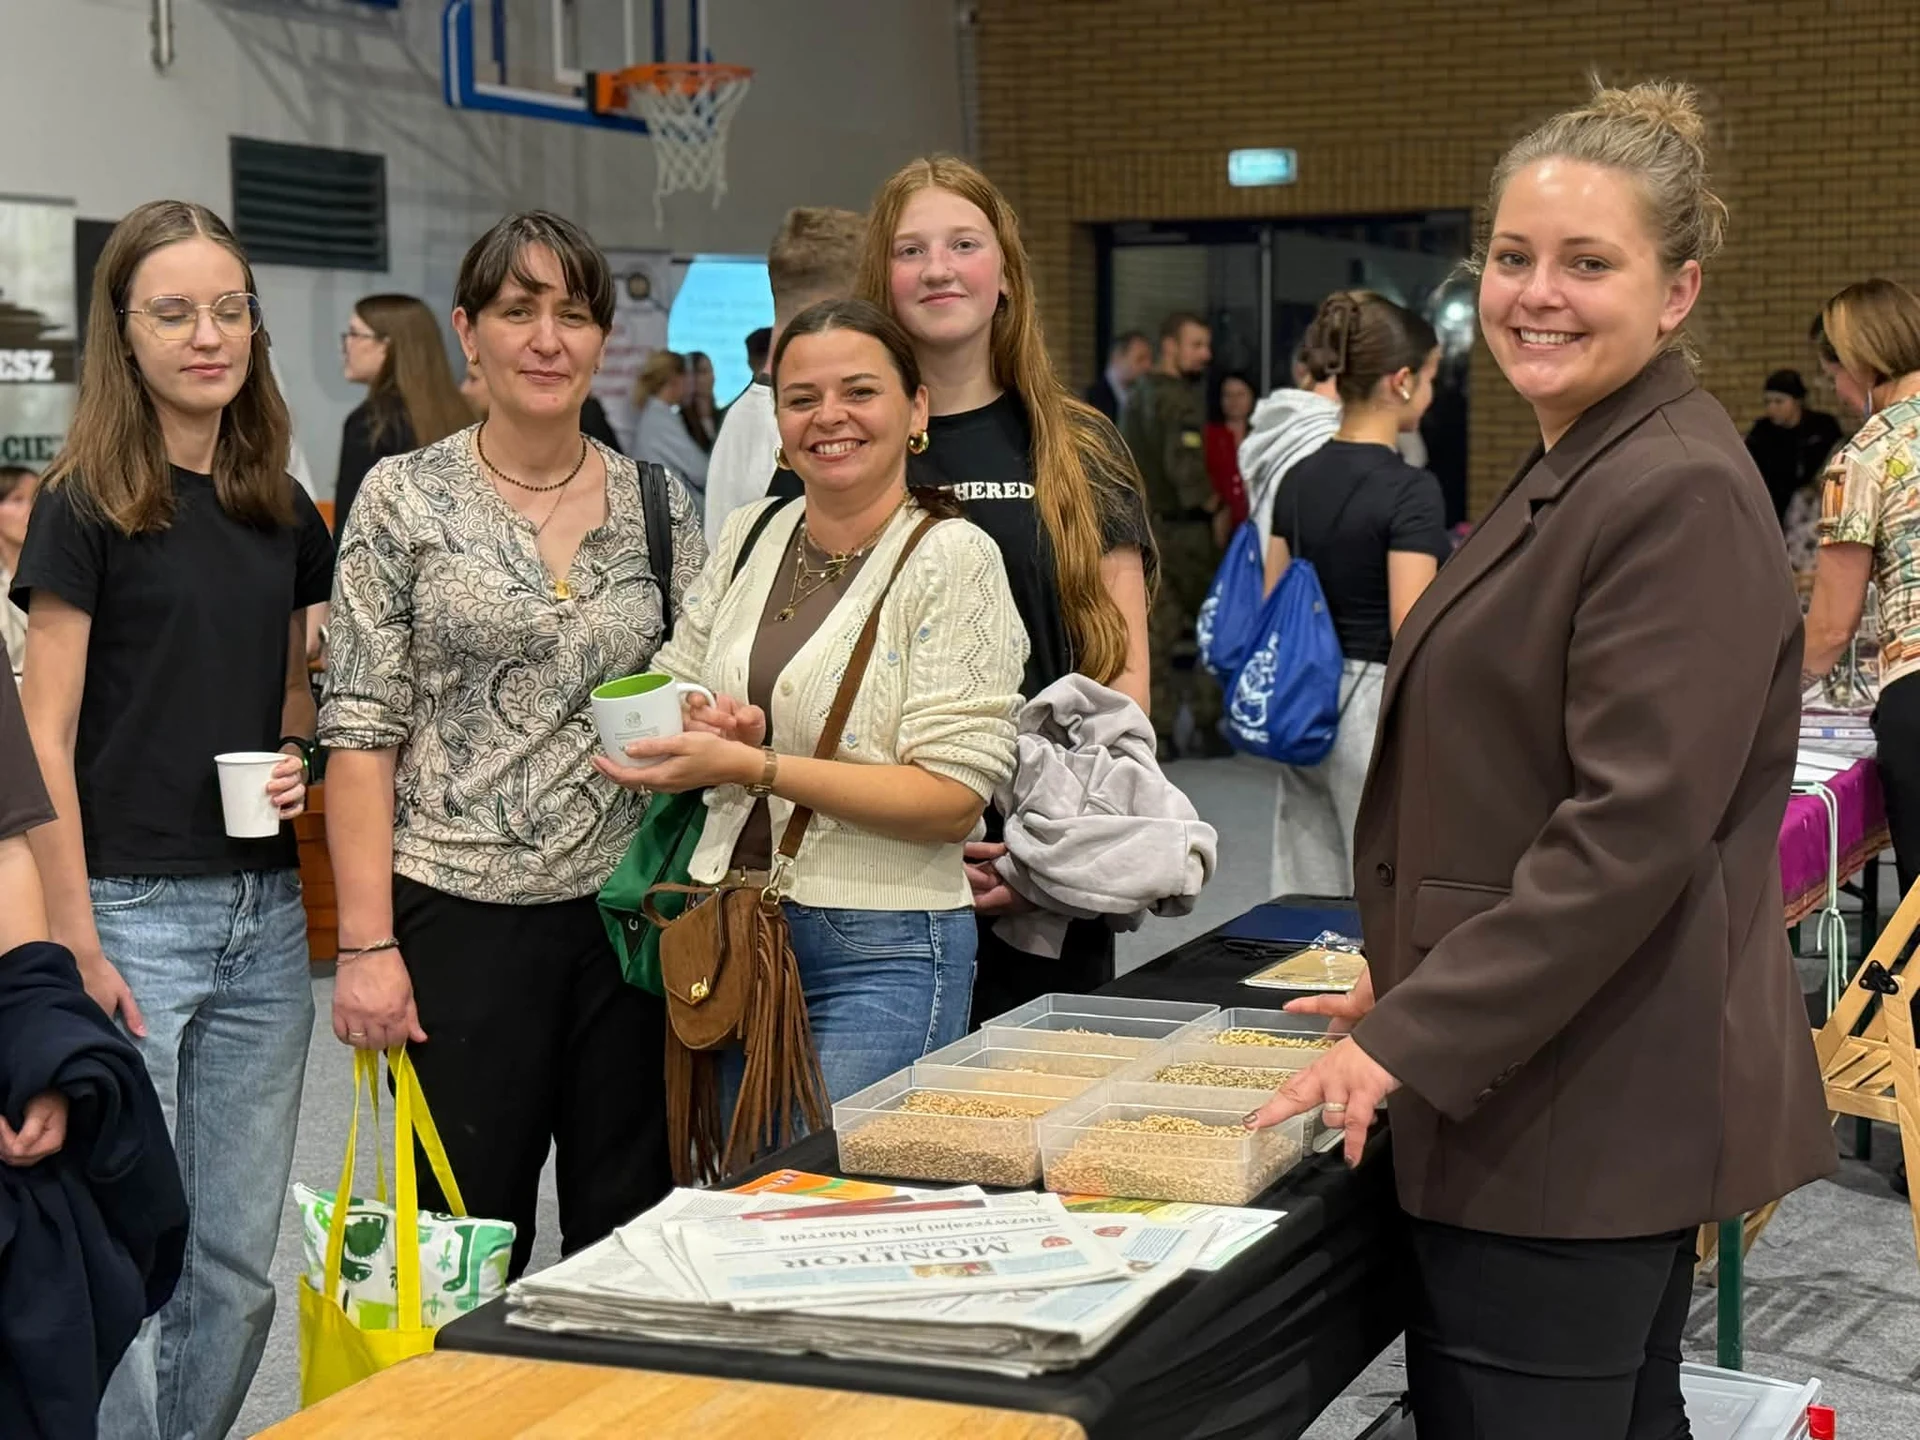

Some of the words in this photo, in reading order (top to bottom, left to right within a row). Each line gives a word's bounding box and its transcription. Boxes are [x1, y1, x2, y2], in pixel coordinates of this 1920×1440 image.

[863, 1227, 889, 1238] od
[892, 1222, 924, 1235] jak
[779, 1230, 858, 1242] Marvela
[779, 1242, 1012, 1269] MONITOR
